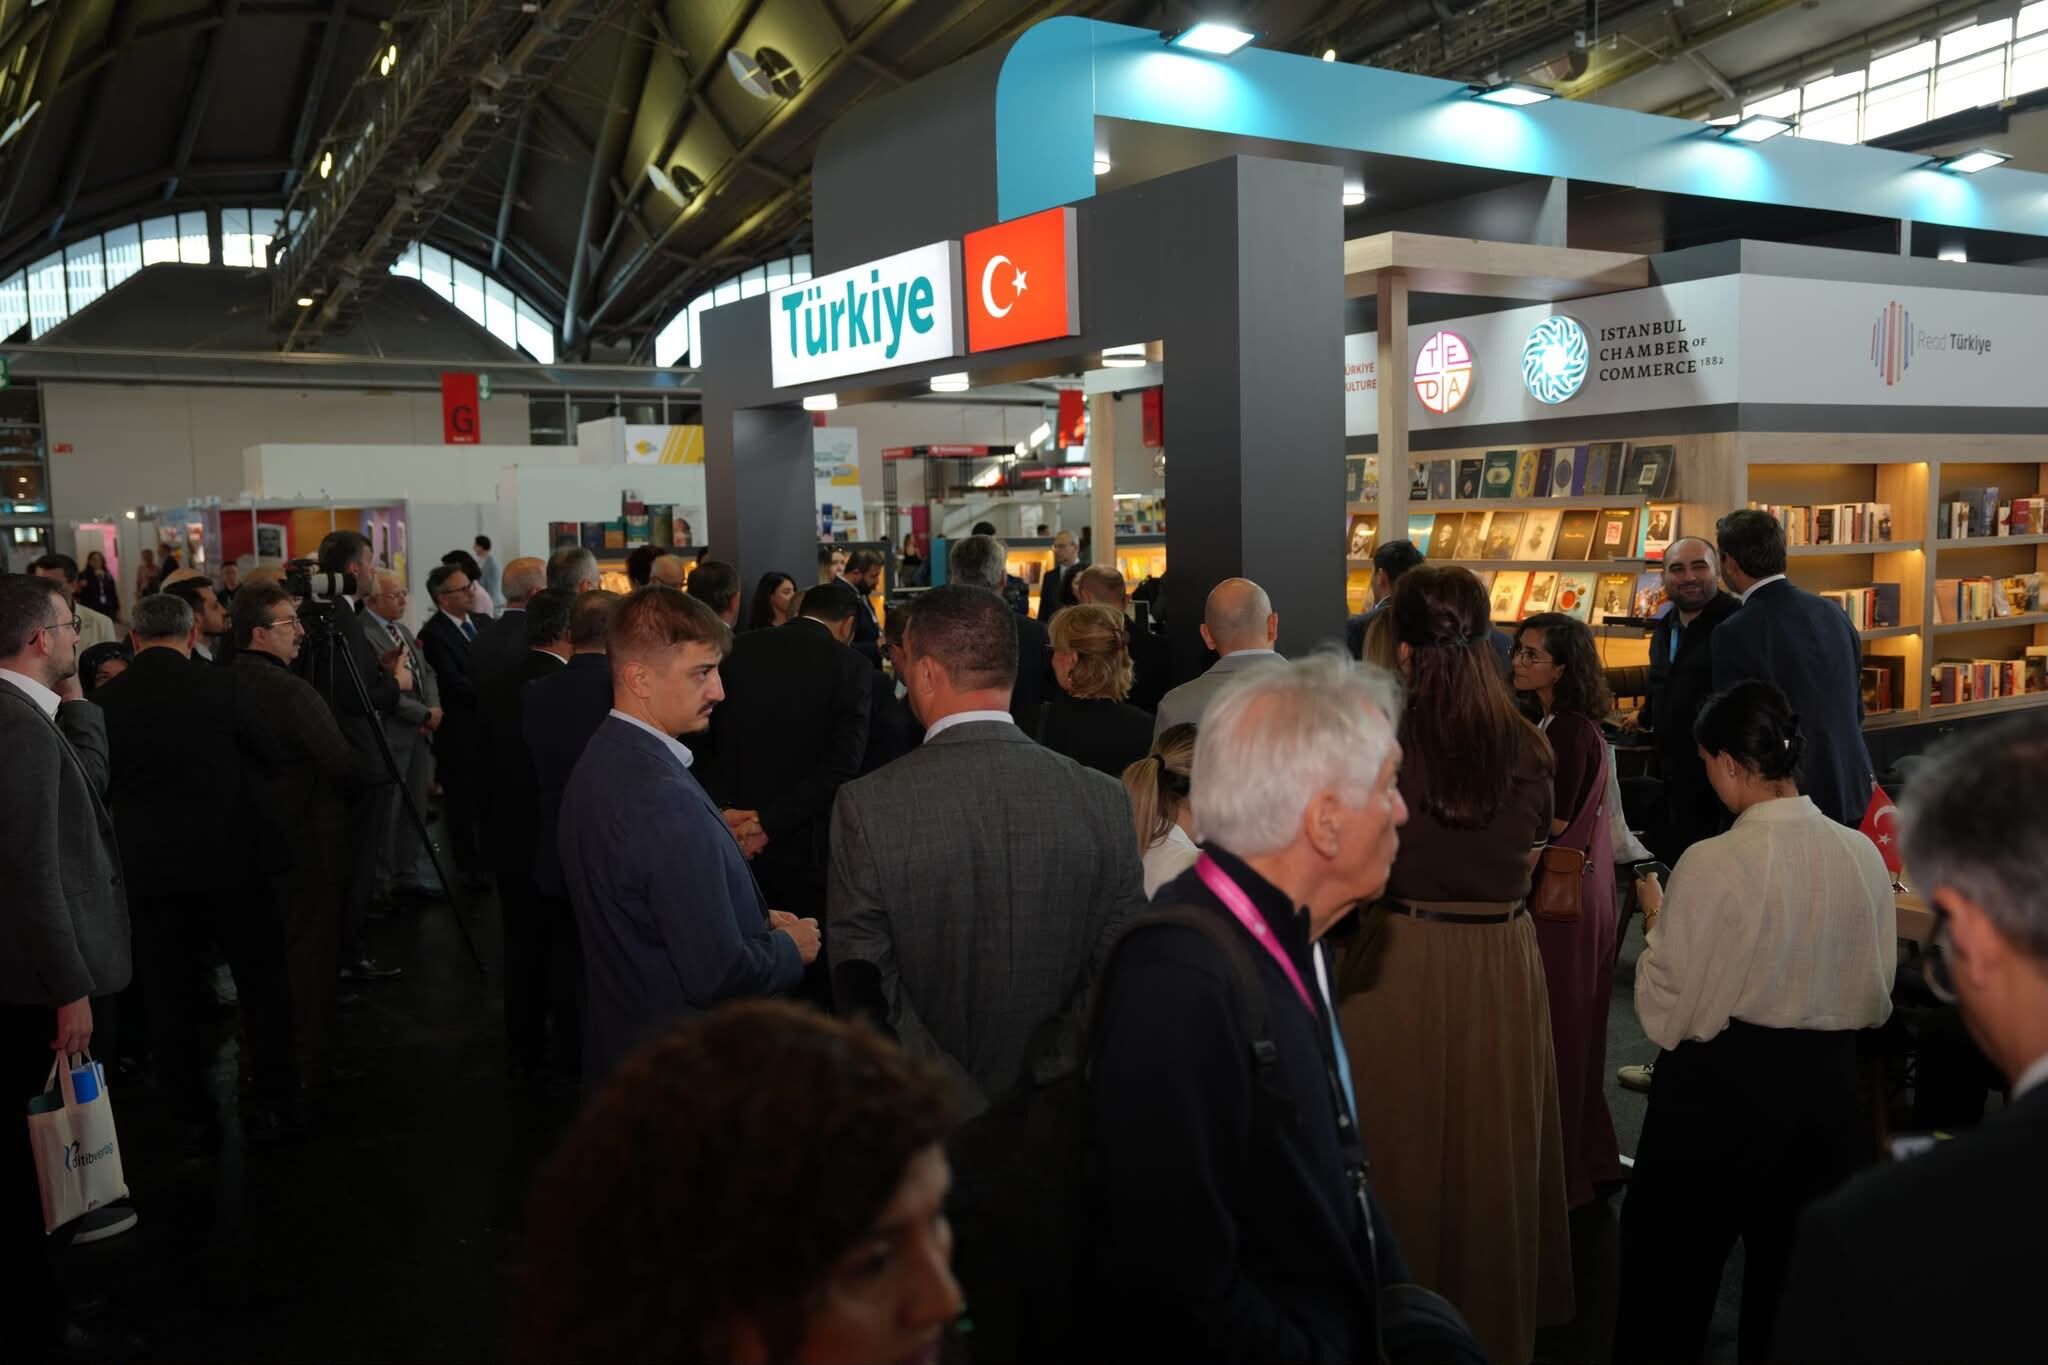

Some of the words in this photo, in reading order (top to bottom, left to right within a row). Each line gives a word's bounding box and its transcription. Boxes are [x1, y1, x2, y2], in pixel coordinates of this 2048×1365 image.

[782, 269, 934, 359] Türkiye
[1600, 319, 1686, 341] ISTANBUL
[1600, 340, 1689, 361] CHAMBER
[1692, 337, 1707, 347] OF
[1950, 333, 1992, 355] Türkiye
[1599, 360, 1697, 381] COMMERCE
[1700, 356, 1724, 367] 1882
[452, 405, 474, 433] G
